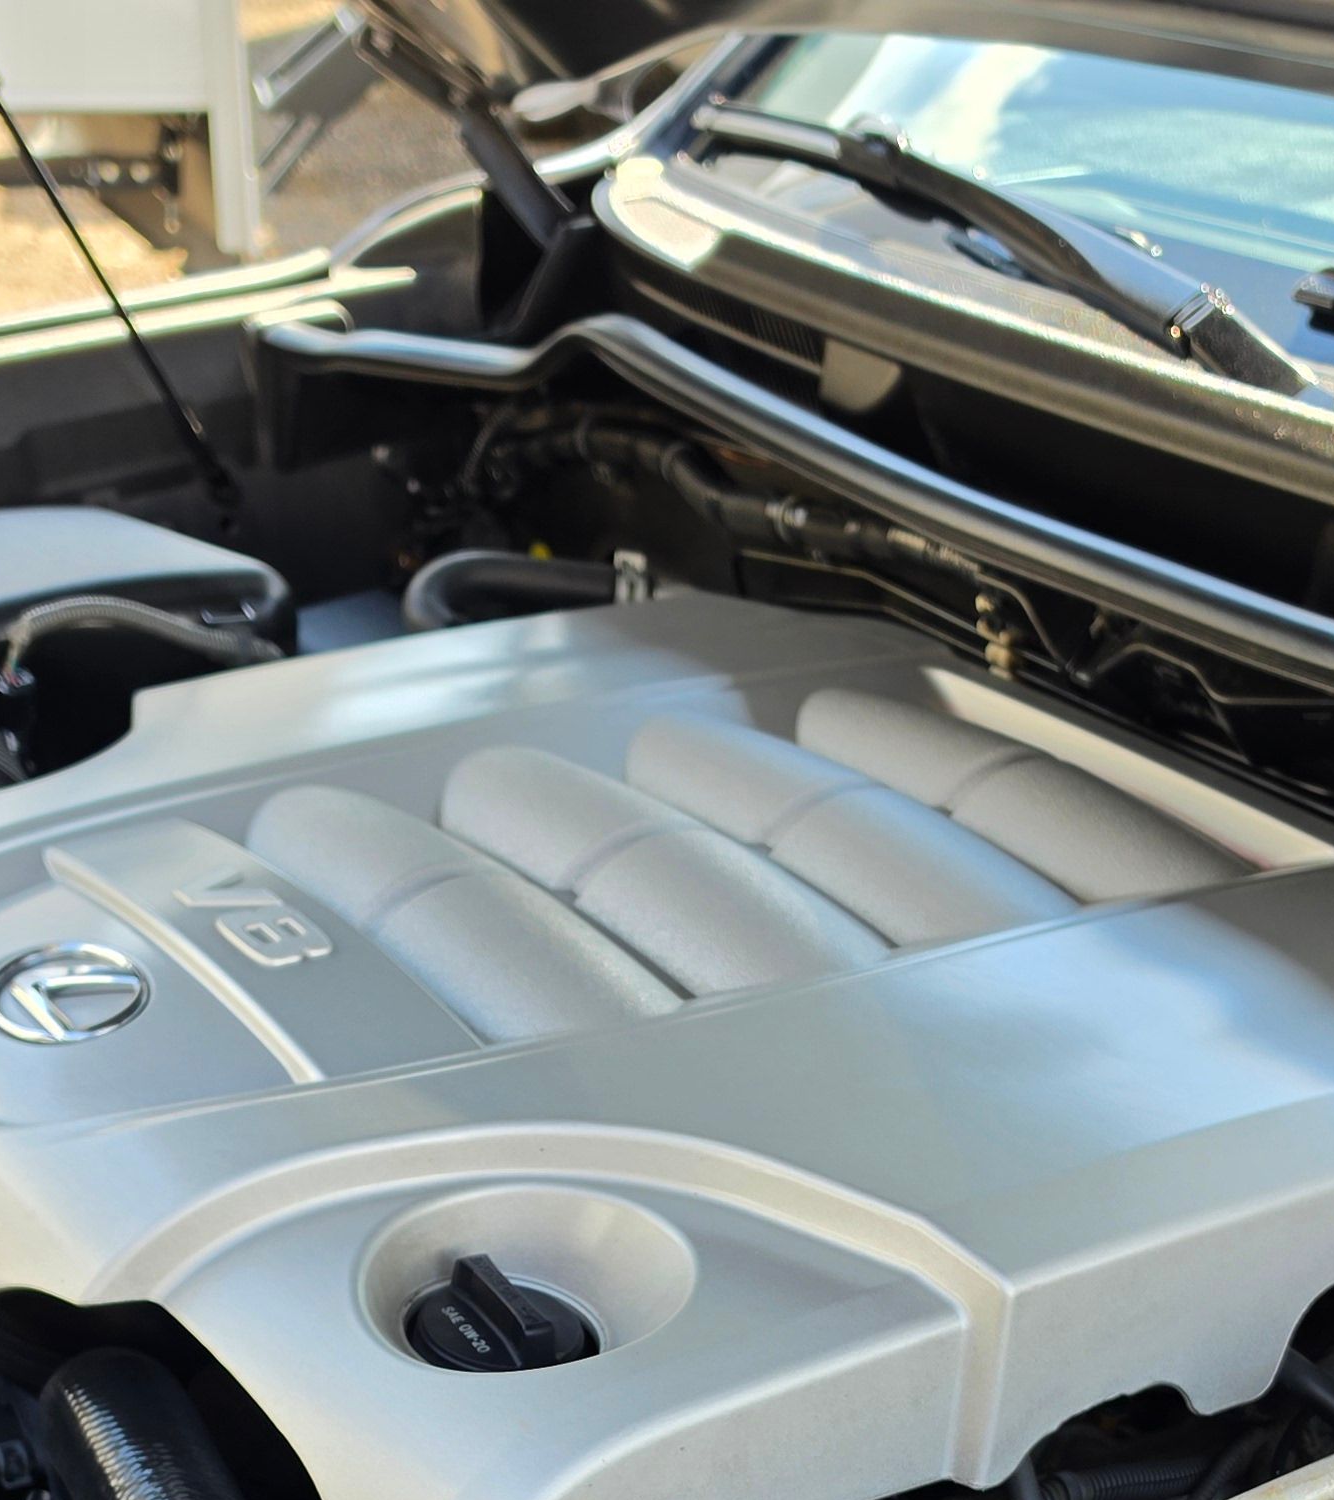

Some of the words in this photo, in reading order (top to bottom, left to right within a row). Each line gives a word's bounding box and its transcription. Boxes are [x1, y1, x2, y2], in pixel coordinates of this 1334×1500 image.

[172, 870, 333, 968] V8
[441, 1305, 465, 1326] SAE
[458, 1322, 491, 1354] 0W-20
